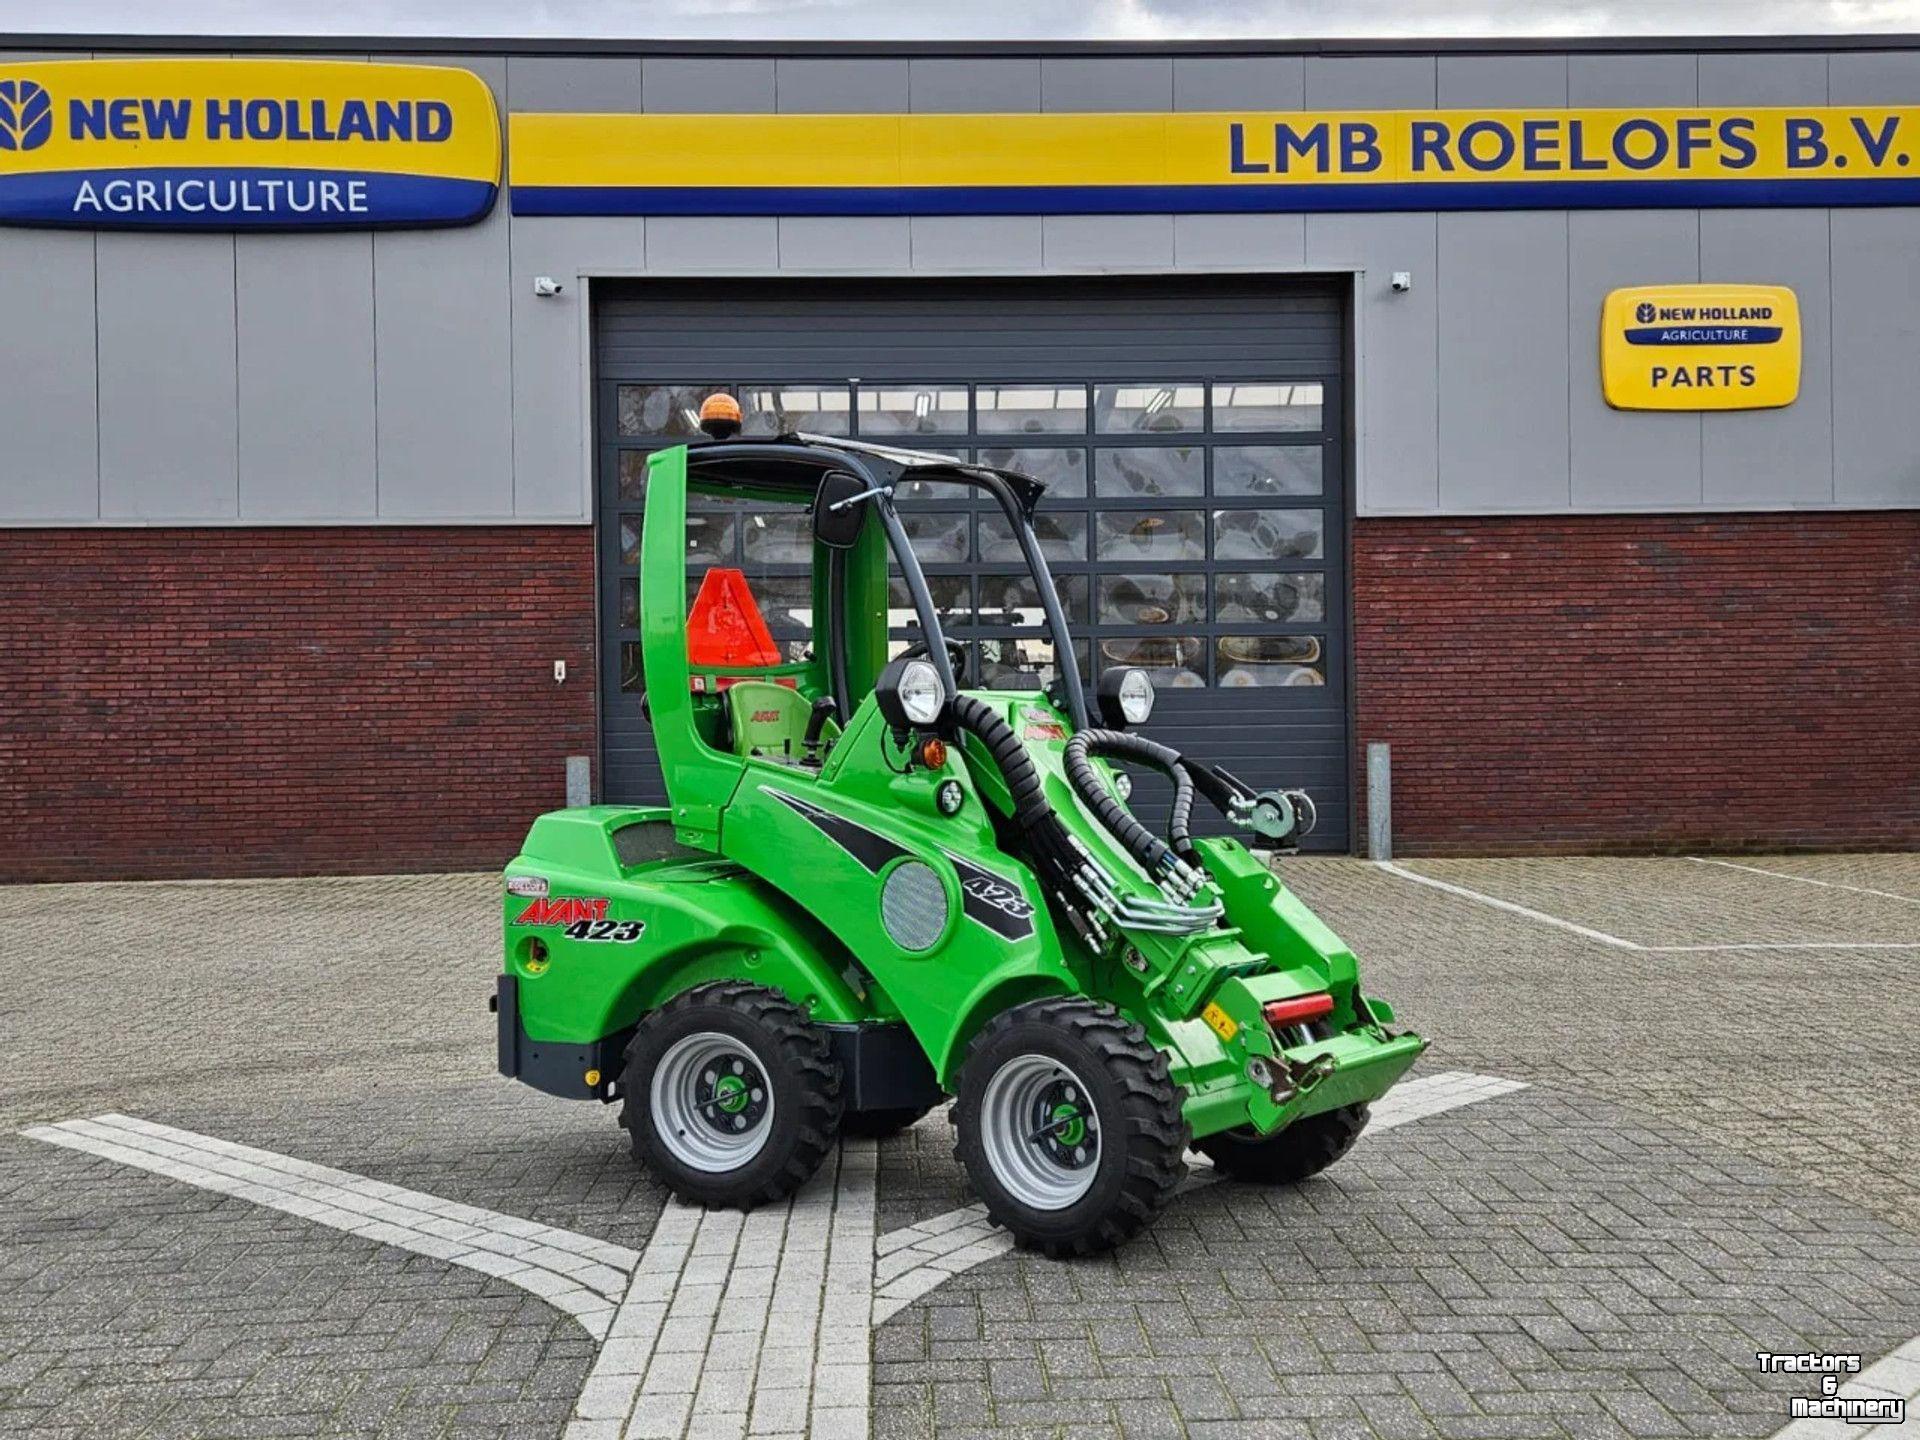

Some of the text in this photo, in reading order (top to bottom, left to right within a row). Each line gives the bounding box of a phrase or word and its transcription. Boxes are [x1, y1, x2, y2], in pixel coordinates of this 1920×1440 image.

[69, 99, 453, 142] NEW HOLLAND
[1229, 116, 1910, 174] LMB ROELOFS B.V.
[73, 179, 369, 213] AGRICULTURE
[1660, 307, 1772, 321] NEW HOLLAND
[1661, 329, 1748, 340] AGRICULTURE
[1652, 365, 1755, 388] PARTS
[513, 897, 610, 926] AVANT
[962, 876, 1036, 919] 423
[564, 920, 645, 942] 423
